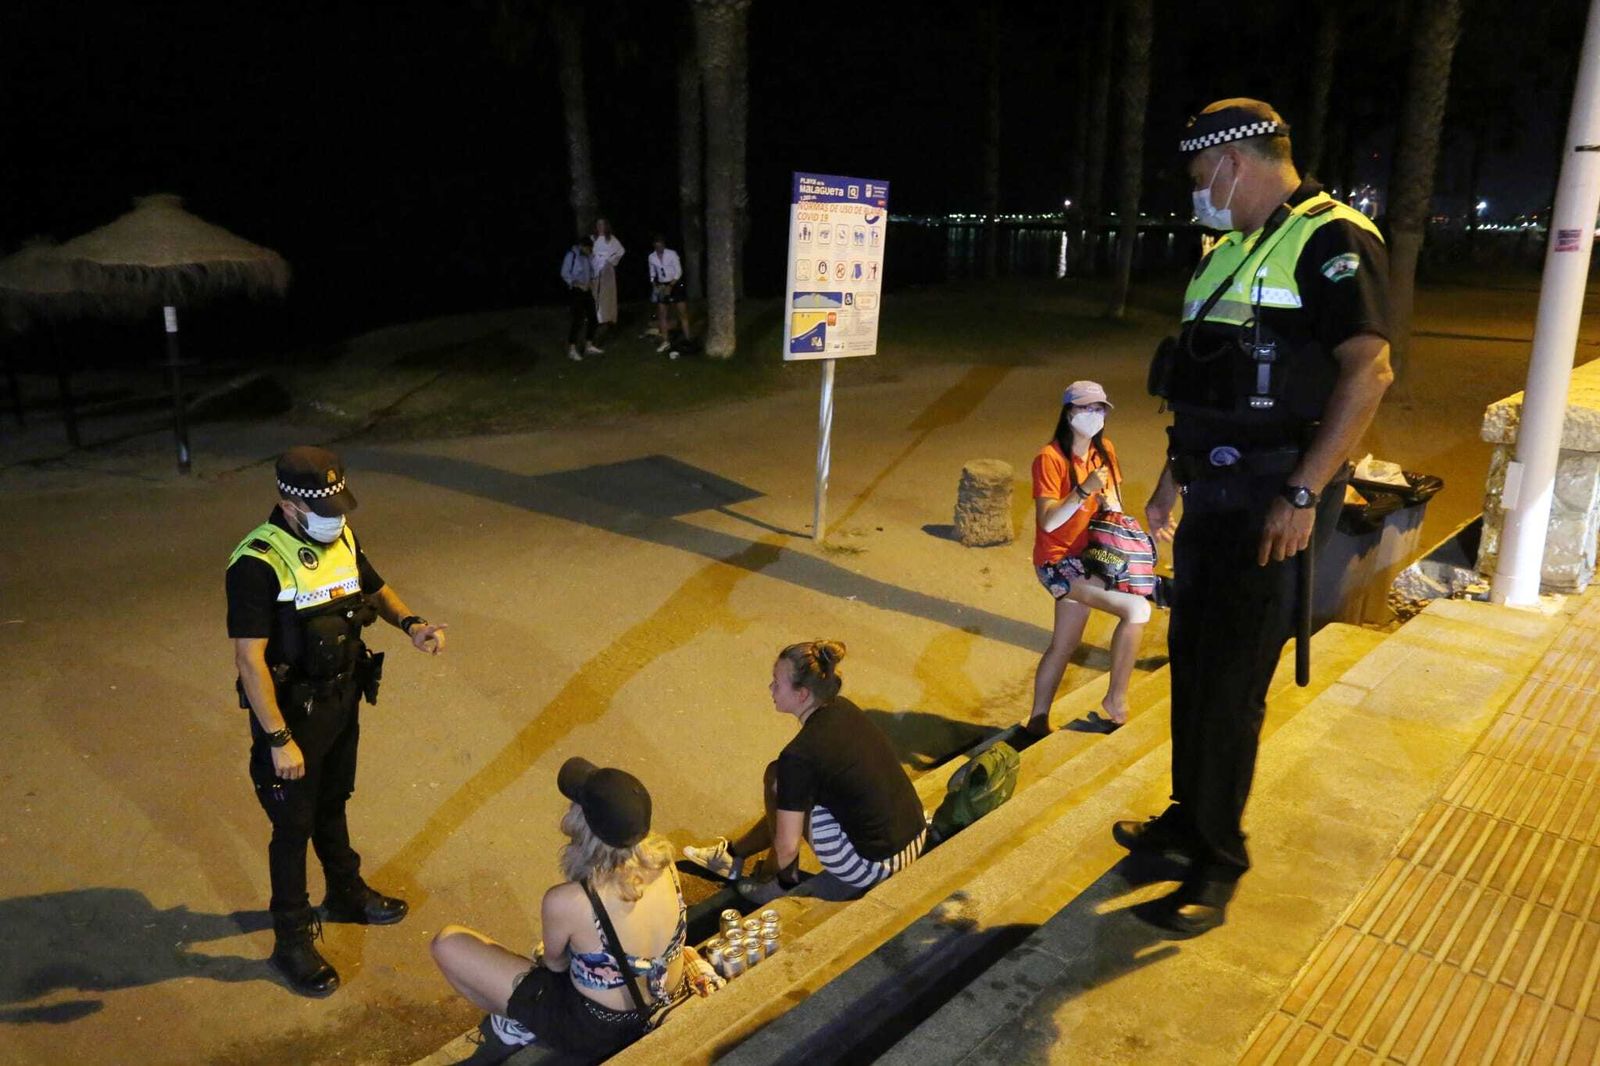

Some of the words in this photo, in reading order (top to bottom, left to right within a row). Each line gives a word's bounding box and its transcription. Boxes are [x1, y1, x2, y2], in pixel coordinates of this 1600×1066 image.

[799, 201, 829, 212] NORMAS
[830, 204, 839, 213] DE
[798, 212, 819, 221] COVID
